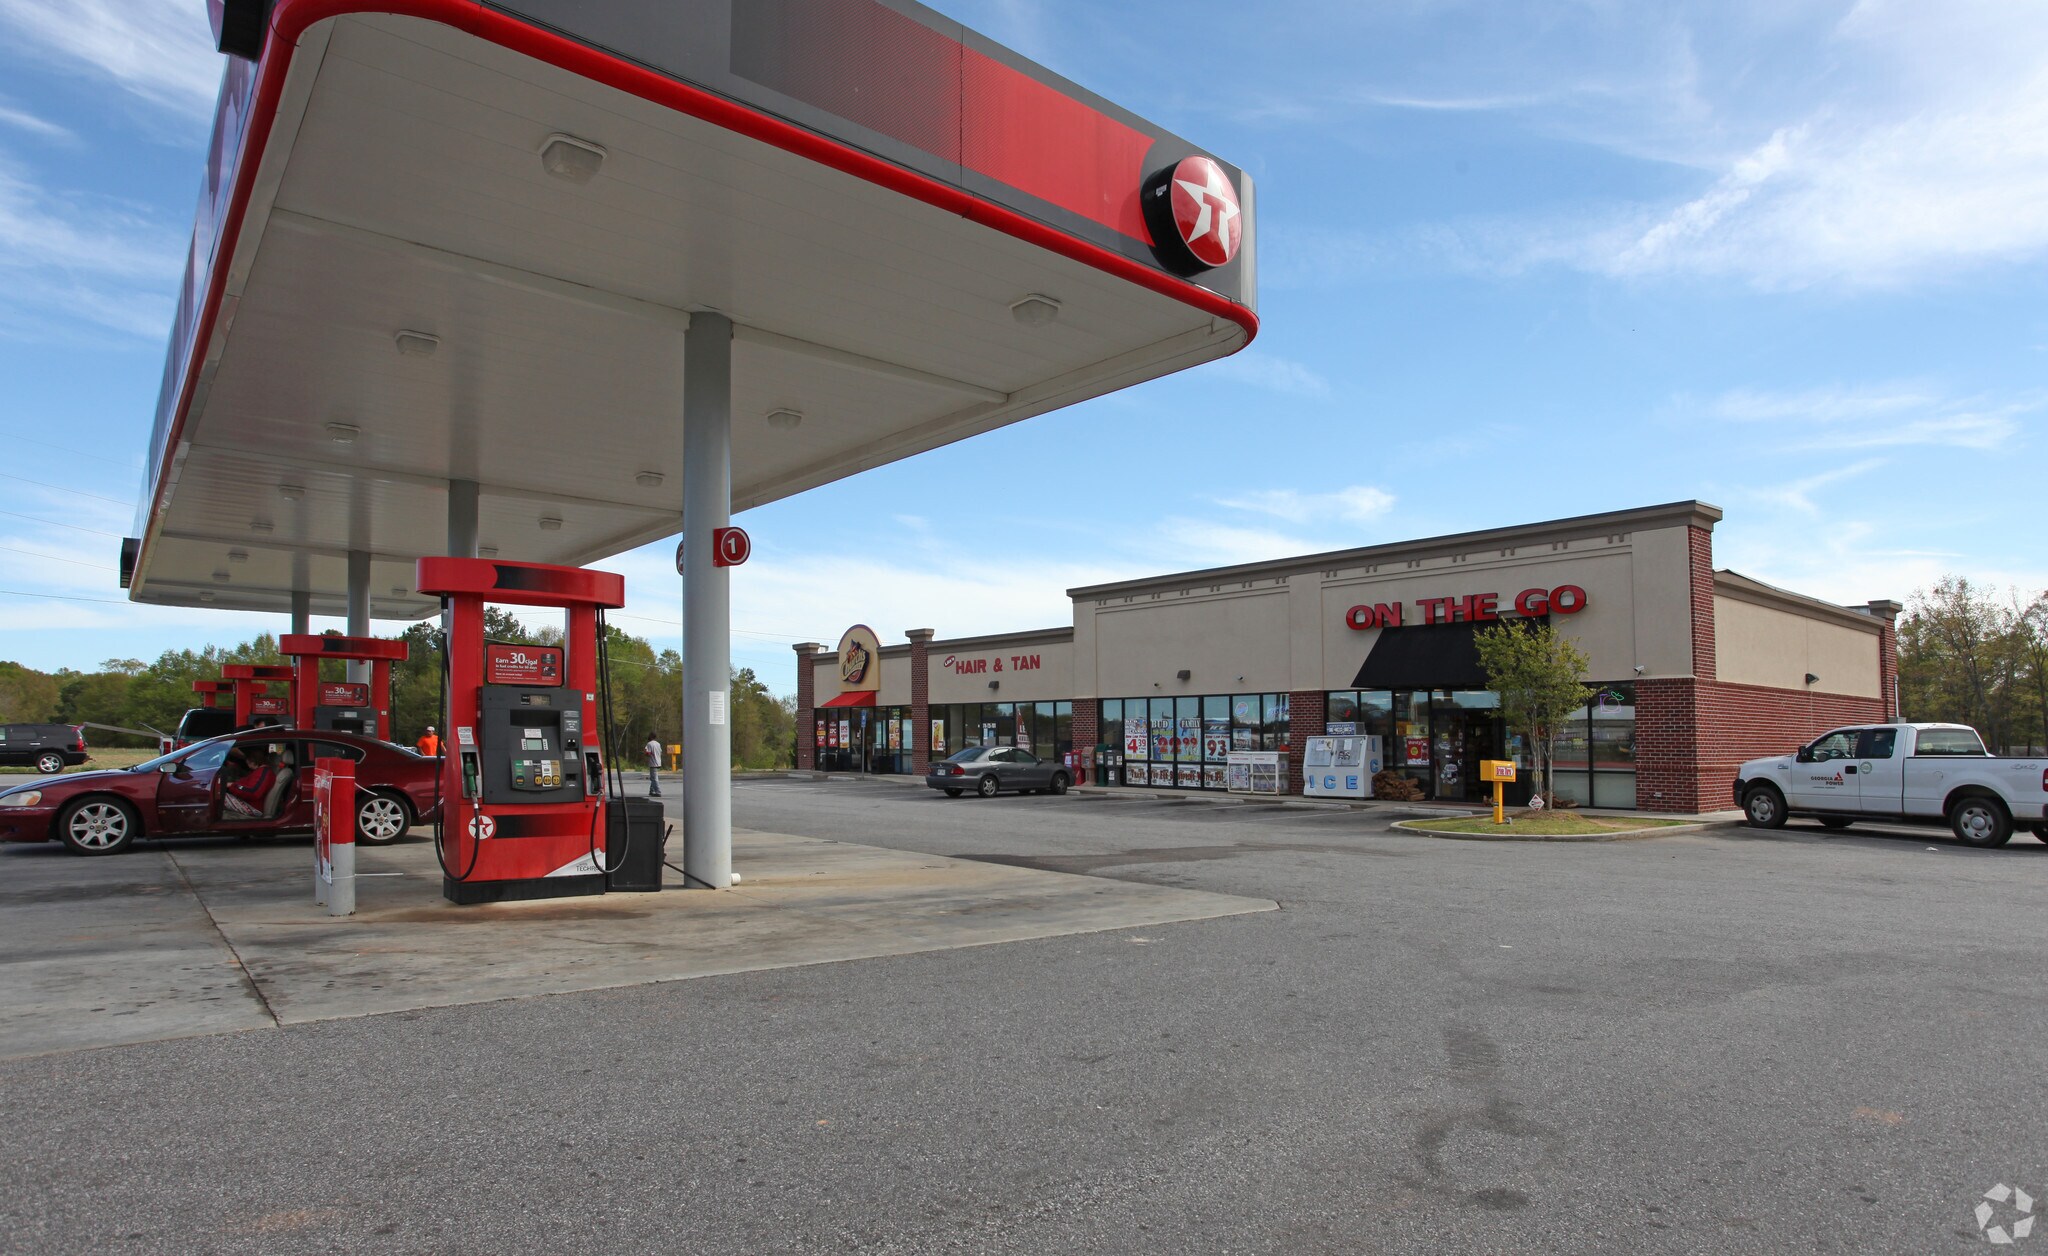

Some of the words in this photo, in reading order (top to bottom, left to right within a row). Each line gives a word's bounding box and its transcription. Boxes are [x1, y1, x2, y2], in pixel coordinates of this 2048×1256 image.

[727, 537, 736, 554] 1
[1346, 601, 1402, 630] ON
[1416, 592, 1499, 625] THE
[1515, 584, 1588, 617] GO
[955, 659, 987, 674] HAIR
[993, 657, 1003, 672] &
[1011, 654, 1040, 671] TAN
[1151, 719, 1169, 728] BUD
[1127, 738, 1139, 753] 4
[1207, 740, 1227, 757] 93
[1309, 775, 1359, 789] ICE
